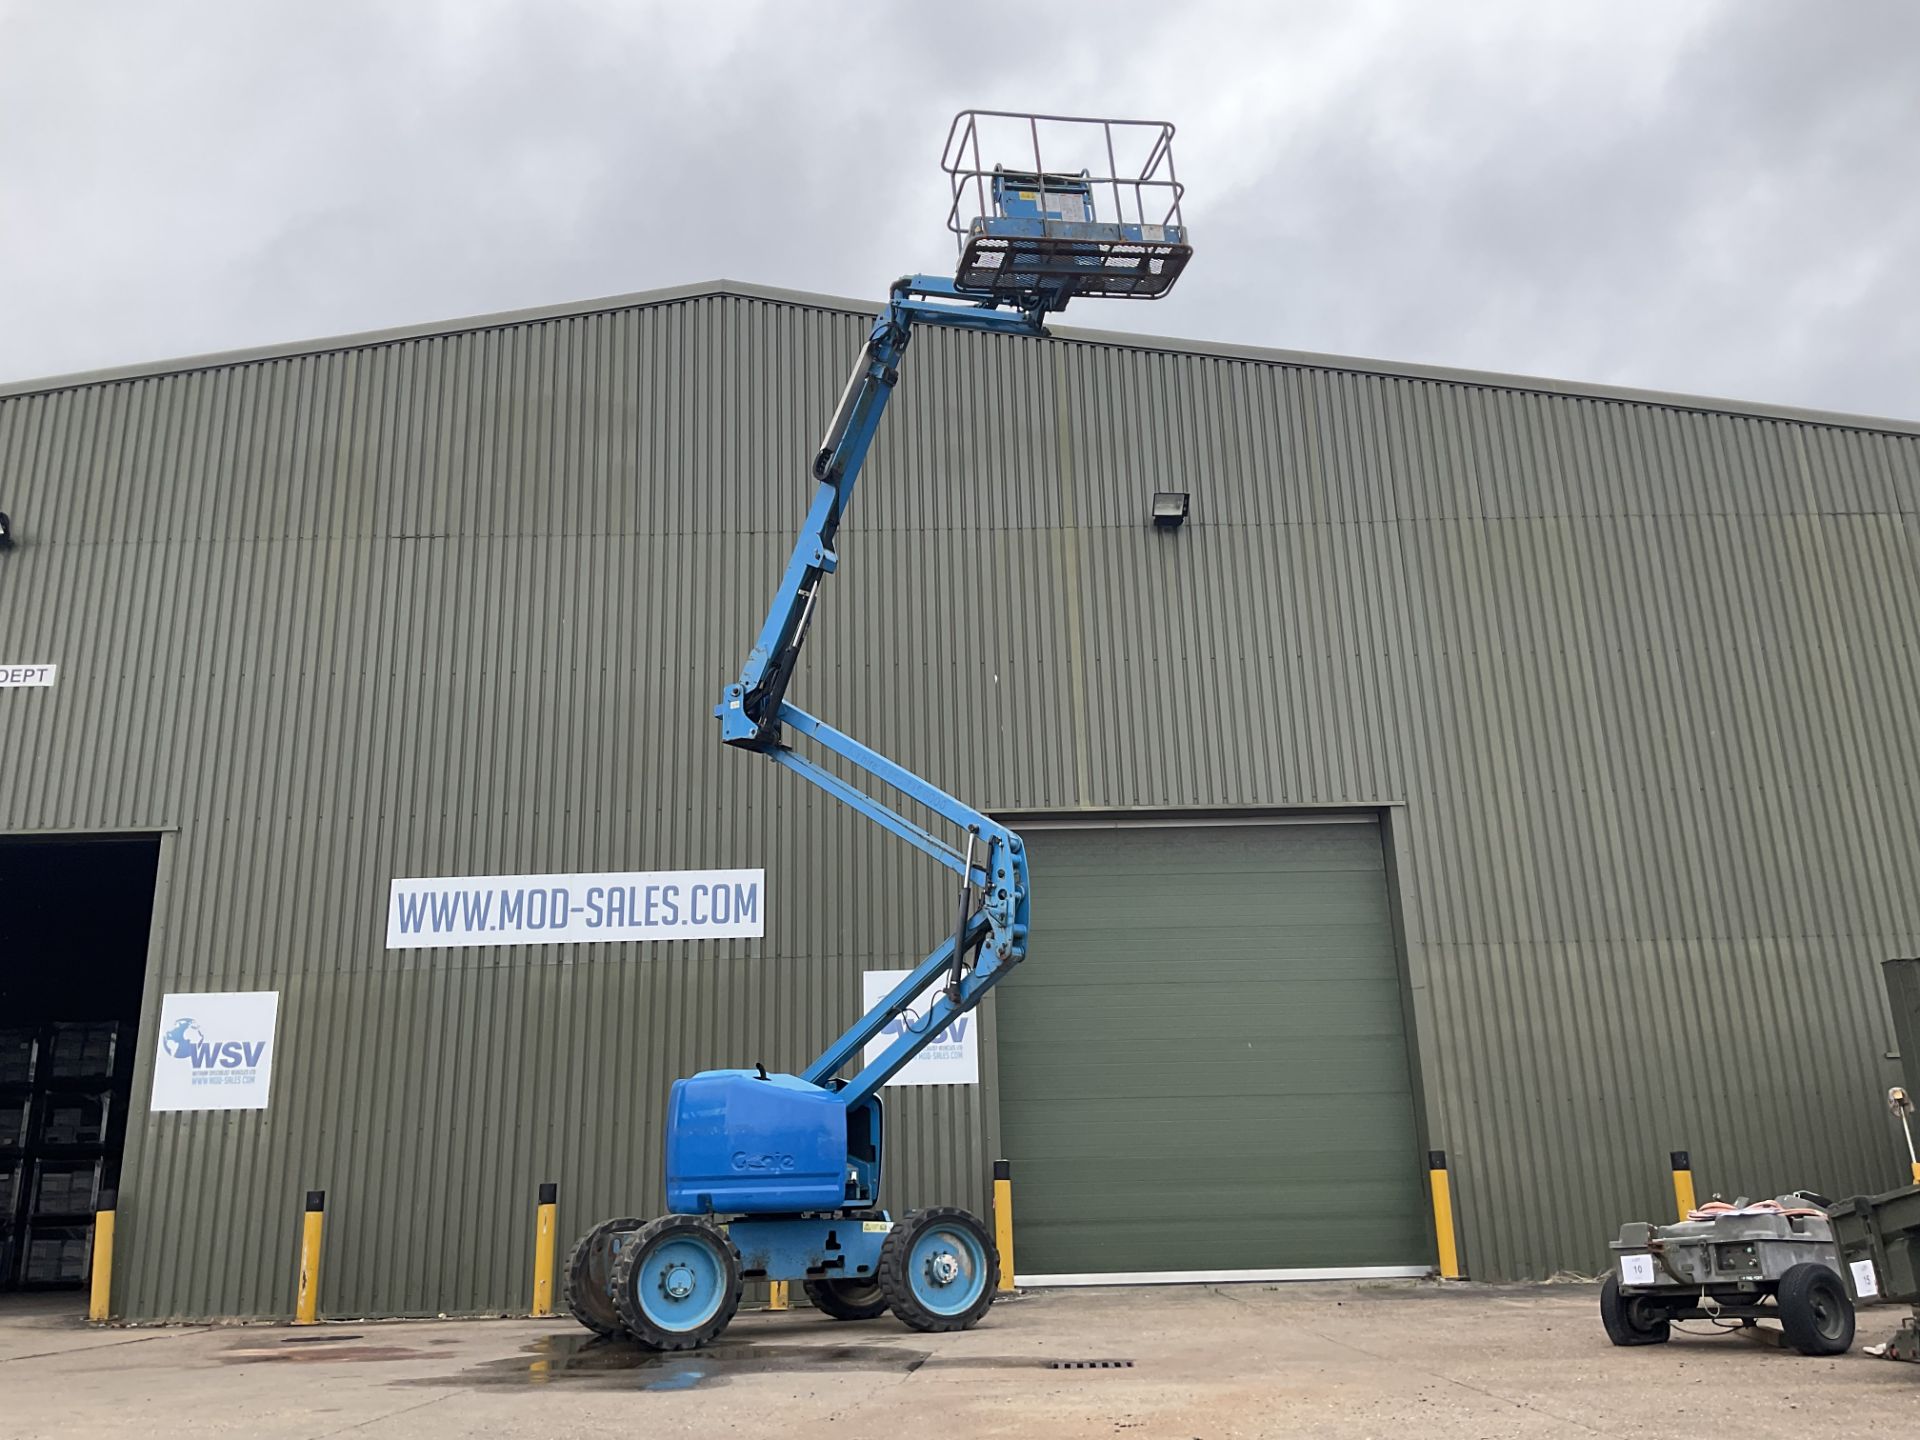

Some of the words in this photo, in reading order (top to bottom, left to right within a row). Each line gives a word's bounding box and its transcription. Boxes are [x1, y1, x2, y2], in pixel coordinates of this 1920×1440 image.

[398, 882, 758, 934] WWW.MOD-SALES.COM
[190, 1041, 266, 1068] WSV
[731, 1151, 794, 1172] Genie
[1633, 1265, 1643, 1274] 10
